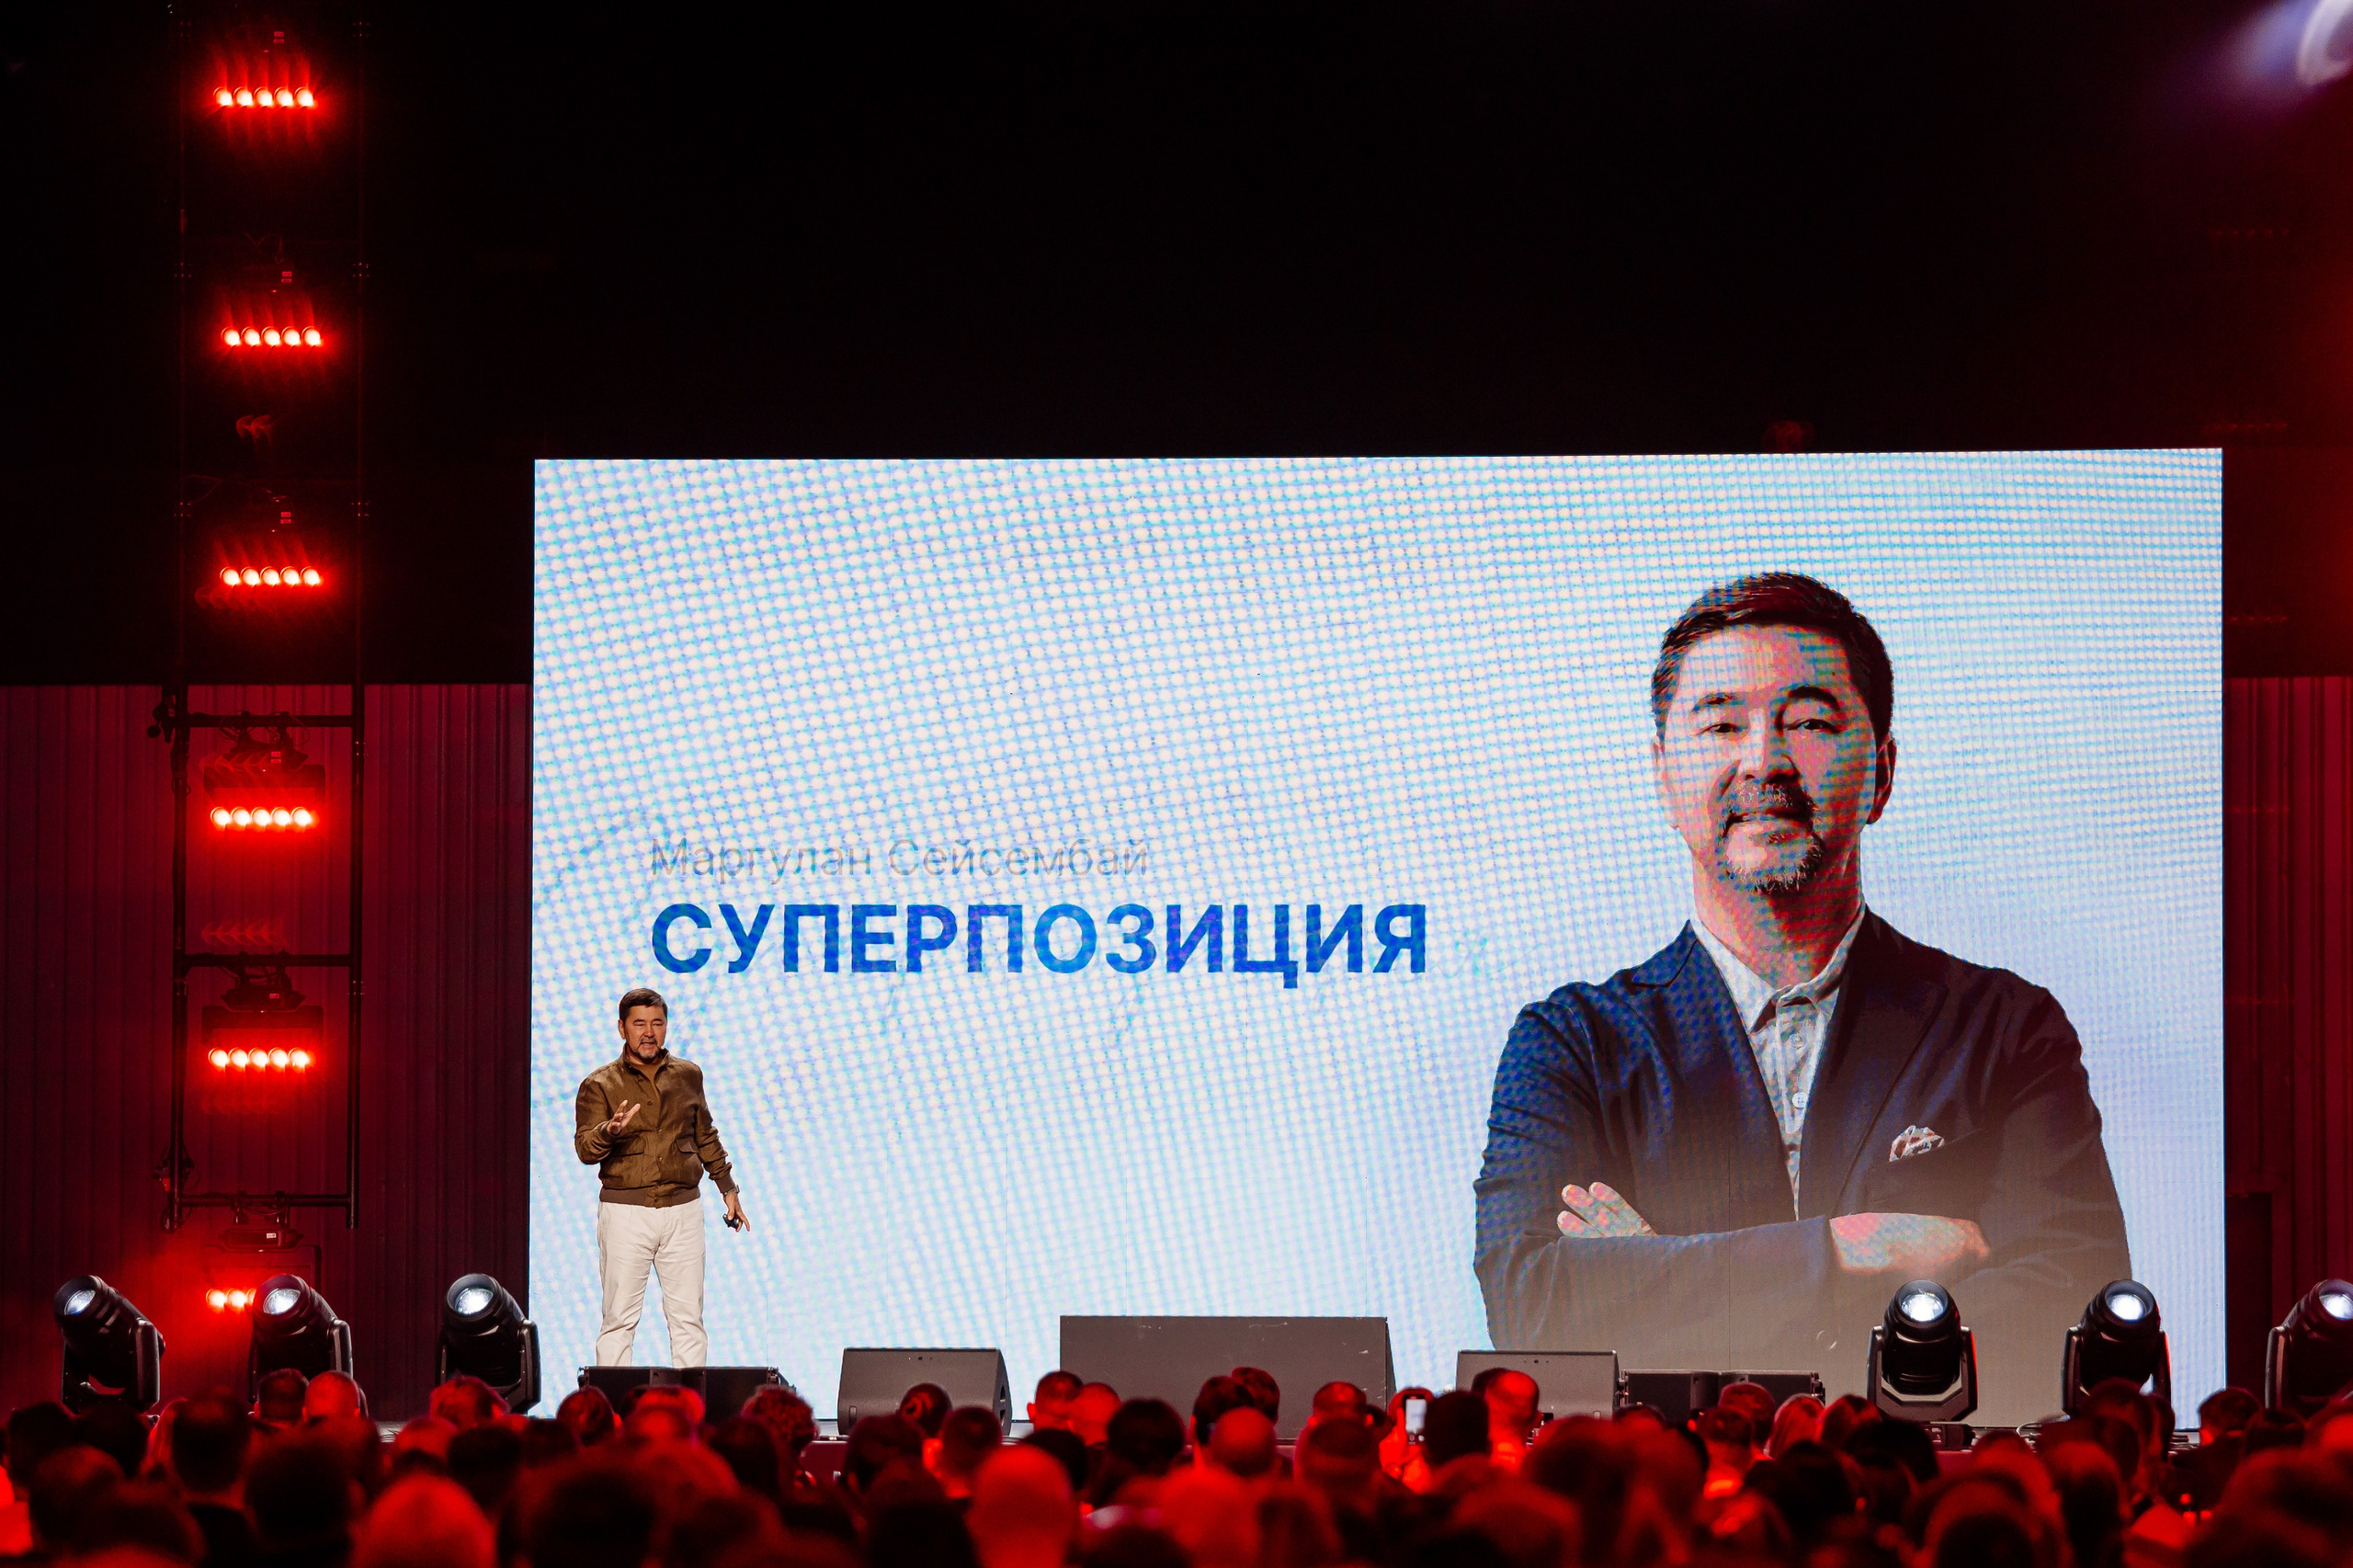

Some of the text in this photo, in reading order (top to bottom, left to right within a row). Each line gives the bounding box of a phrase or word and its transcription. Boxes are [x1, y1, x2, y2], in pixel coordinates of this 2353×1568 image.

[650, 837, 1148, 885] Маргулан Сейсембай
[652, 903, 1427, 988] СУПЕРПОЗИЦИЯ
